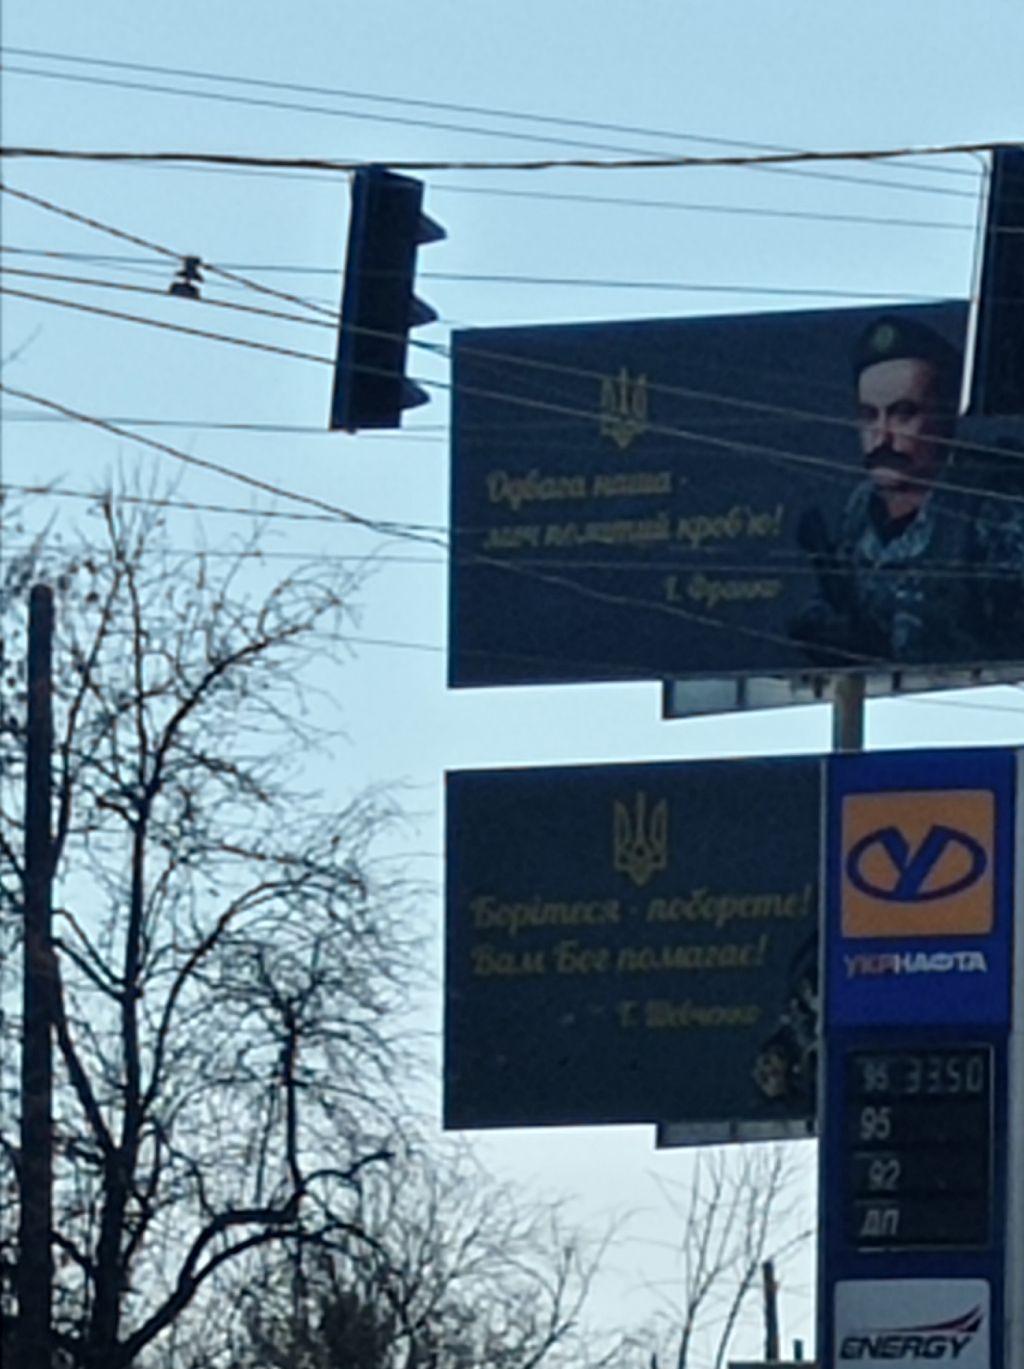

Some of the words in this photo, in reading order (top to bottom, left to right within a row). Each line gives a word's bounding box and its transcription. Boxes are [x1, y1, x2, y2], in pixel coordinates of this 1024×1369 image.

[472, 895, 621, 937] Борітеся
[647, 883, 812, 928] поборете!
[472, 946, 545, 975] Вам
[555, 940, 610, 973] Бог
[844, 951, 988, 980] УКРНАФТА
[861, 1106, 893, 1140] 95
[869, 1159, 900, 1190] 92
[841, 1335, 971, 1359] ENERGY
